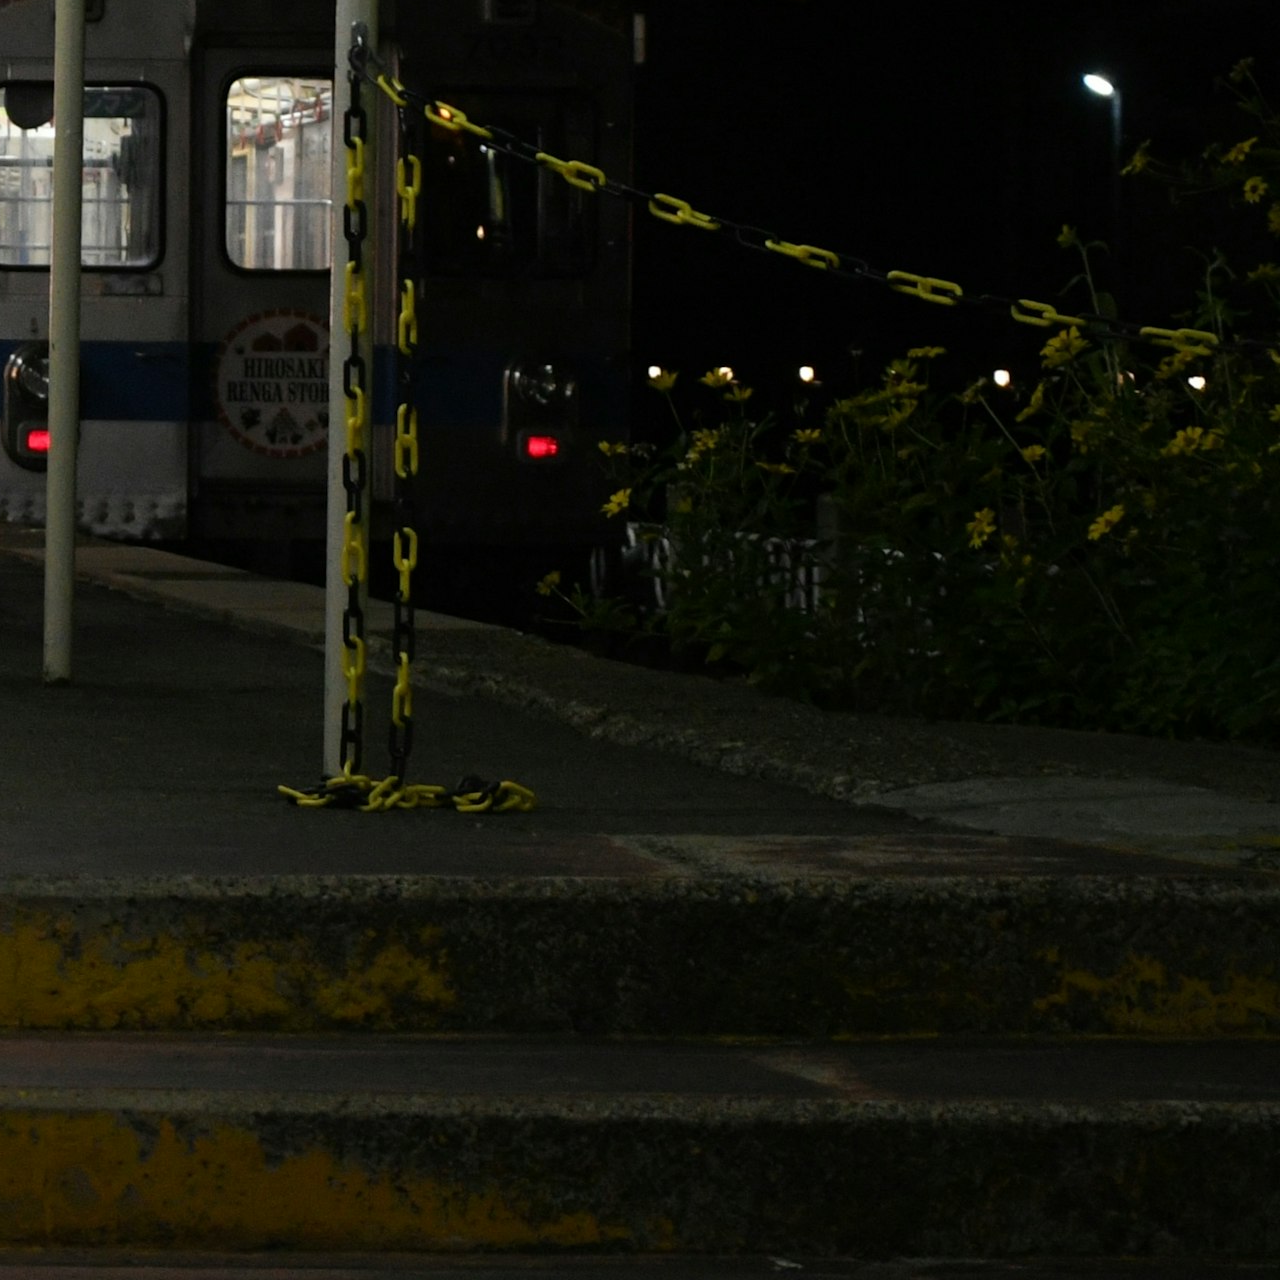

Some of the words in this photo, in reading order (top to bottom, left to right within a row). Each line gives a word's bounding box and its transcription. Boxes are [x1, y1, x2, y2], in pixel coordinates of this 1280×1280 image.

[244, 357, 326, 379] HIROSAKI
[227, 381, 283, 402] RENGA
[288, 380, 330, 402] STOR
